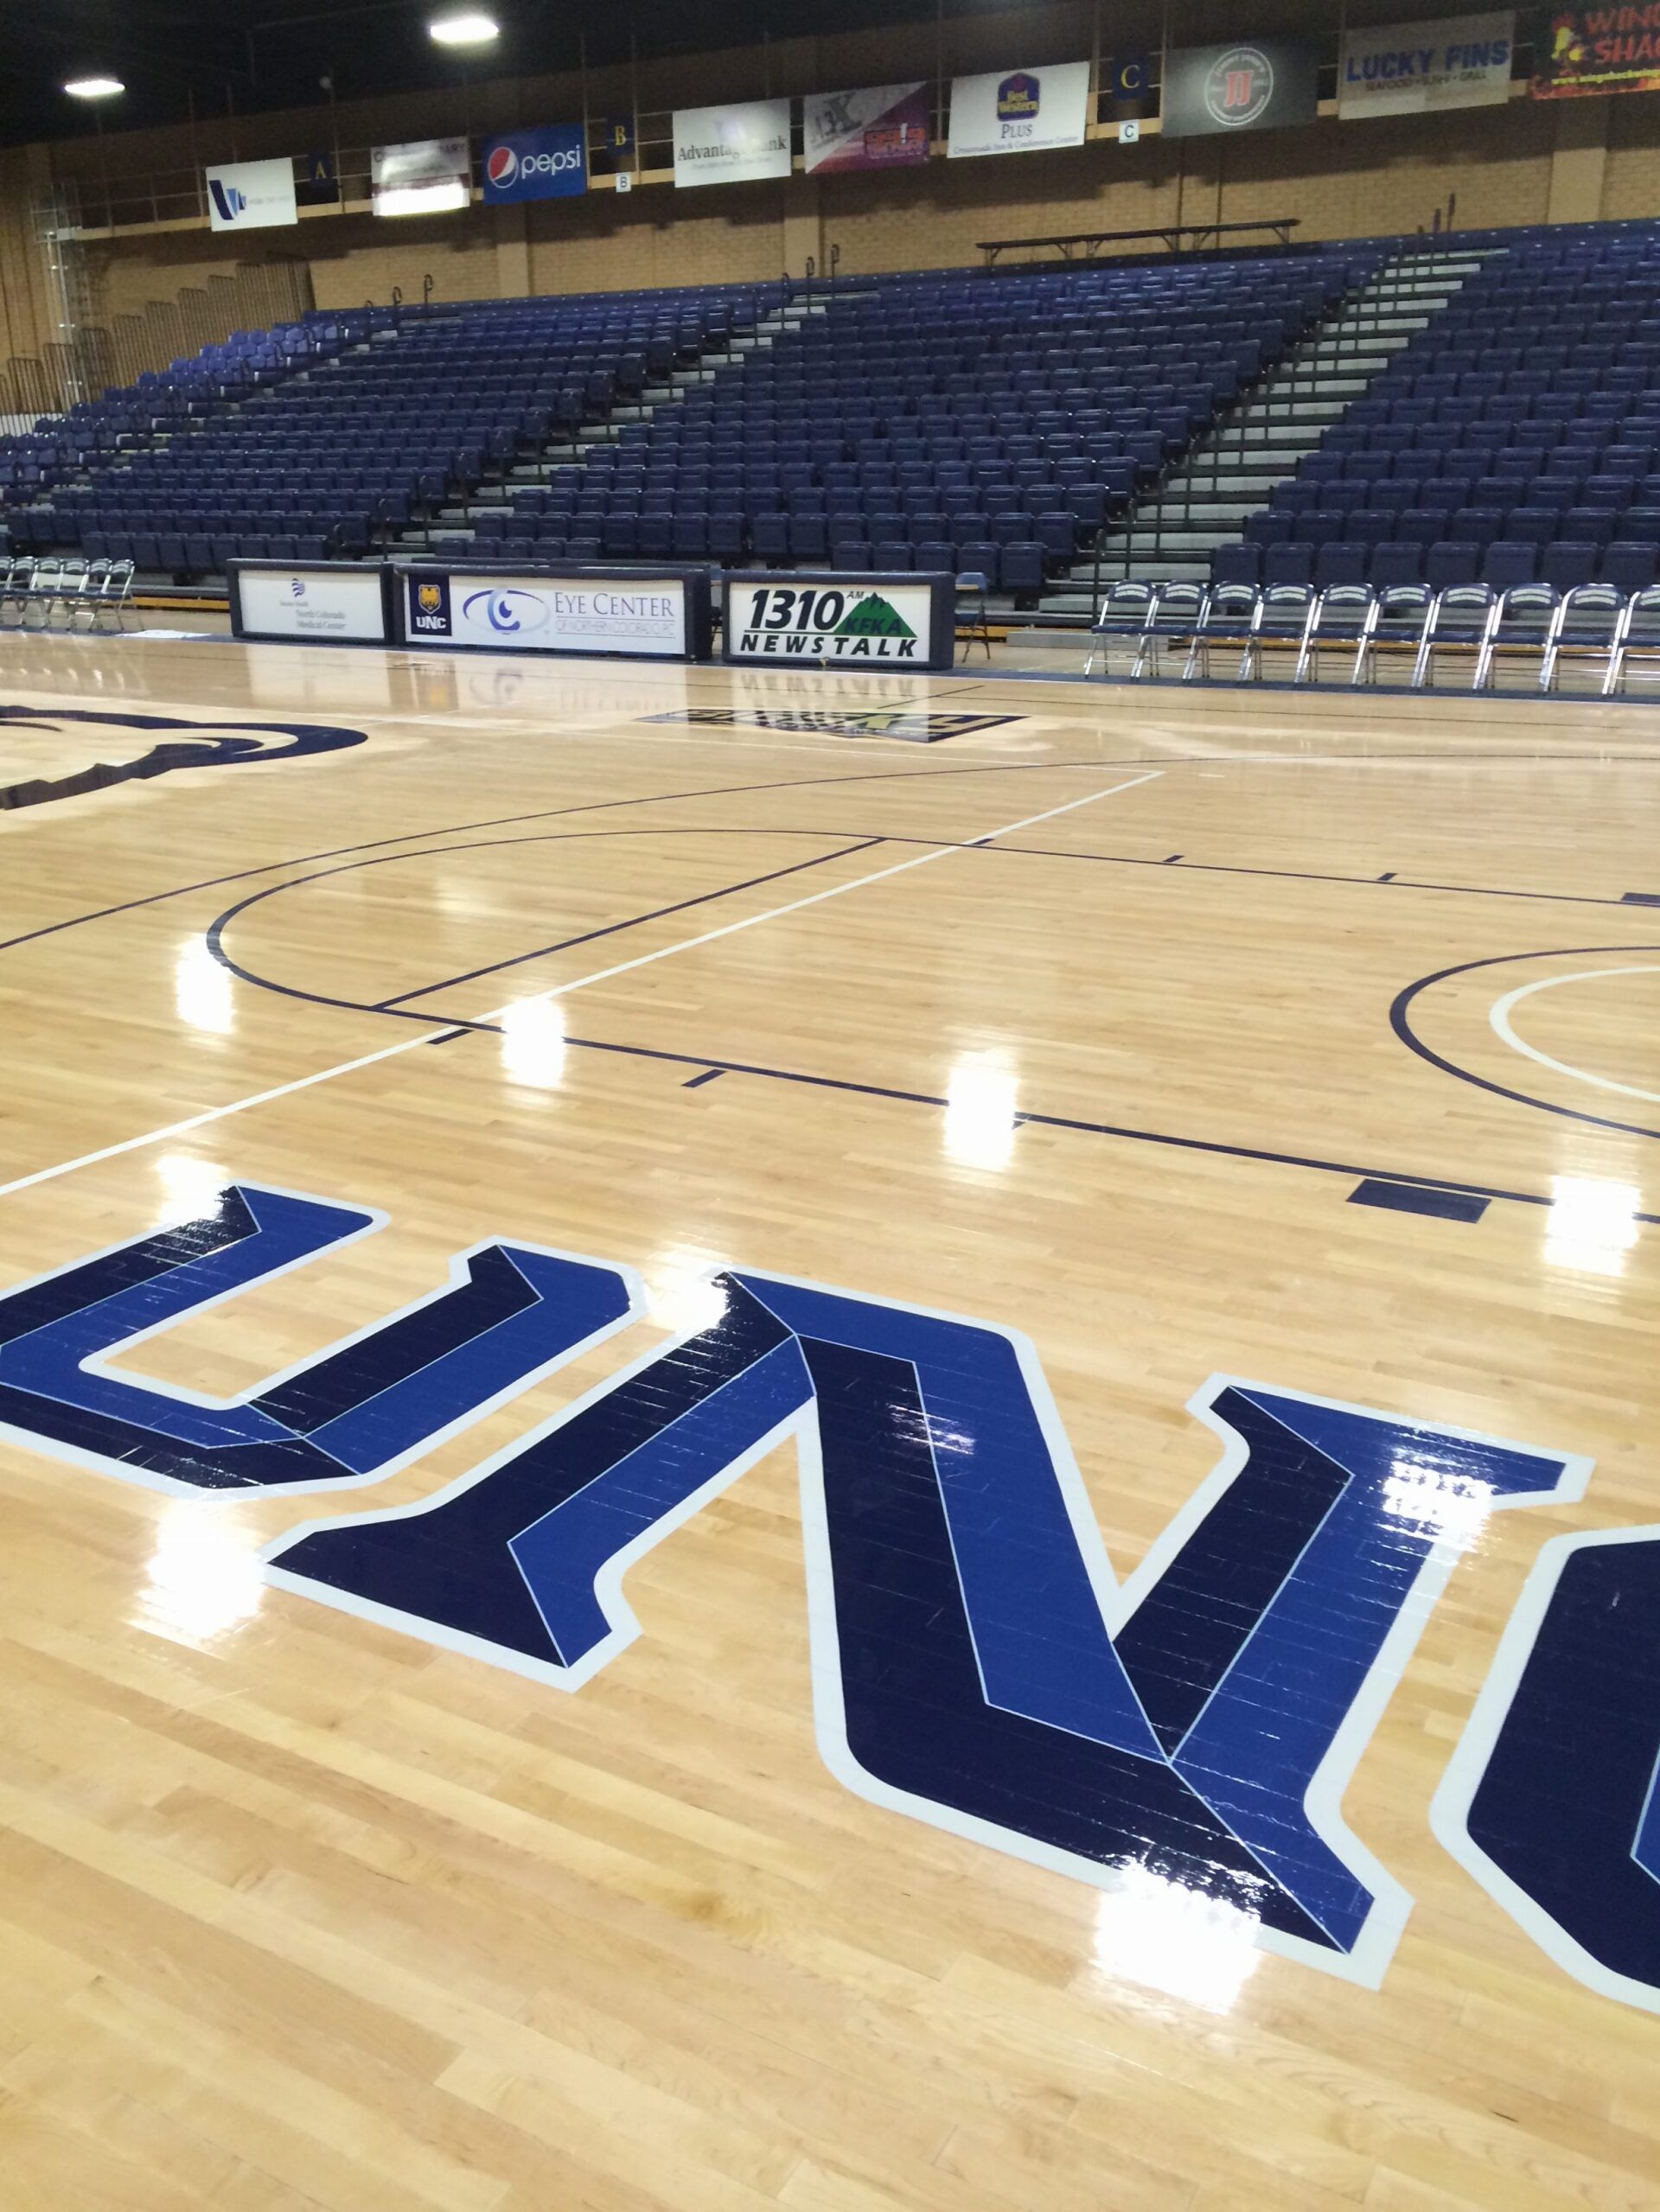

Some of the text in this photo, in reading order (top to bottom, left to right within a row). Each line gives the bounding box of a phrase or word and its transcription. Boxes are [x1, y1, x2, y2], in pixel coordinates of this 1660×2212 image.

[1346, 40, 1510, 82] LUCKY FINS
[1120, 64, 1140, 88] C
[615, 125, 626, 146] B
[1125, 124, 1134, 138] C
[315, 161, 327, 180] A
[521, 144, 582, 179] pepsi
[619, 175, 628, 188] B
[554, 592, 675, 617] EYE CENTER
[750, 589, 865, 631] 1310 AM
[416, 616, 446, 629] UNC
[843, 617, 903, 635] KFKA
